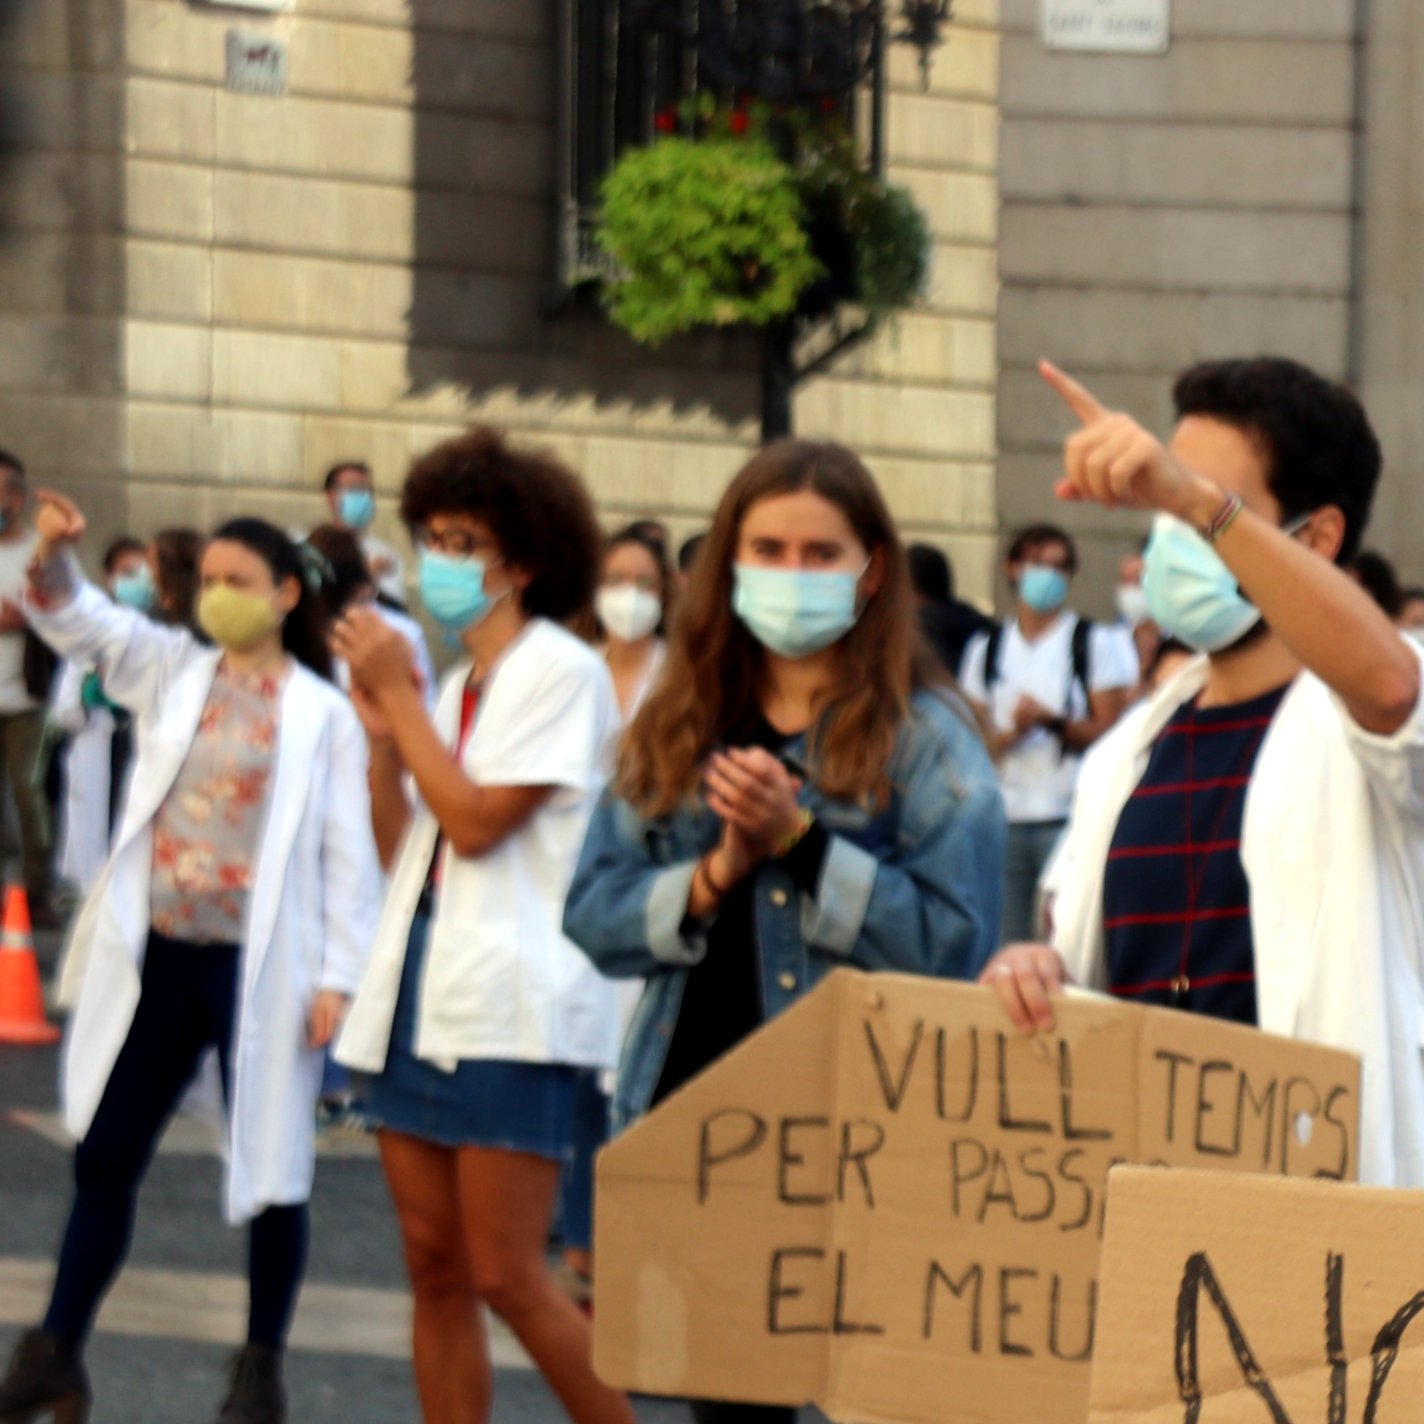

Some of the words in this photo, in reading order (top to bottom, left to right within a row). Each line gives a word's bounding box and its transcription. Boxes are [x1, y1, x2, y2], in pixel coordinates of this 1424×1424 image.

[862, 1017, 1114, 1142] VULL
[1154, 1048, 1350, 1181] TEMPS
[696, 1107, 886, 1207] PER
[949, 1136, 1172, 1241] PASS
[767, 1246, 884, 1337] EL
[922, 1258, 1097, 1361] MEU
